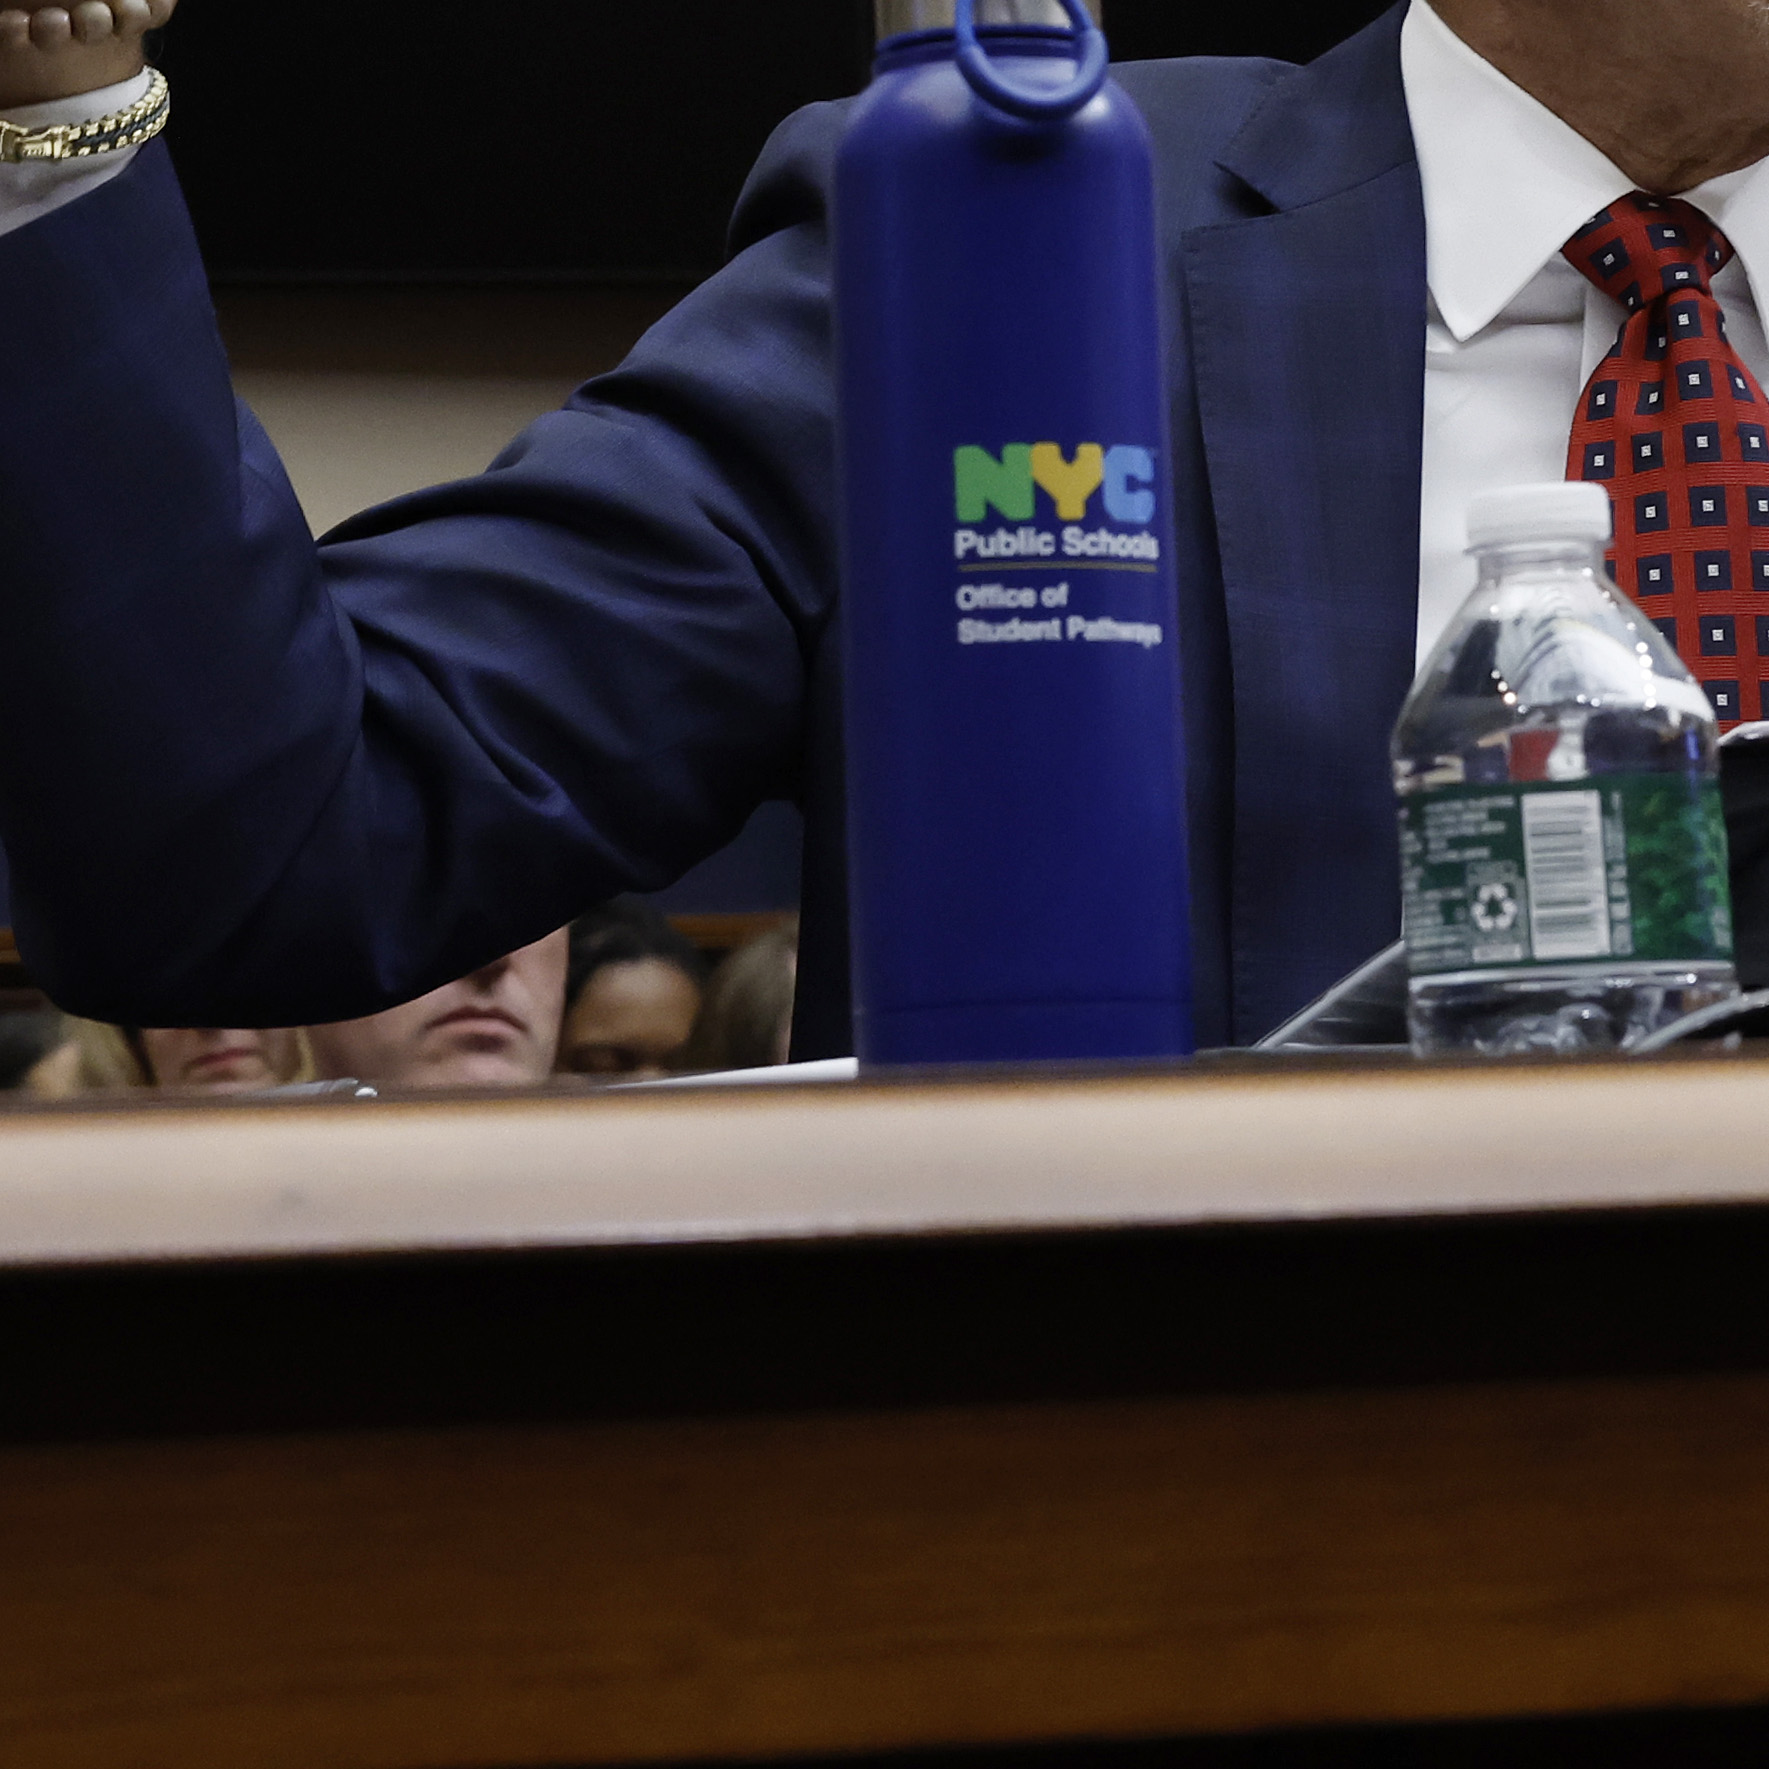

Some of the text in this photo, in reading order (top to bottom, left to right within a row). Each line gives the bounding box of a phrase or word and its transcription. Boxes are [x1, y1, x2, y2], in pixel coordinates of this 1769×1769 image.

[953, 440, 1156, 524] NYC
[954, 525, 1160, 561] Public Schools
[955, 581, 1070, 611] Office of
